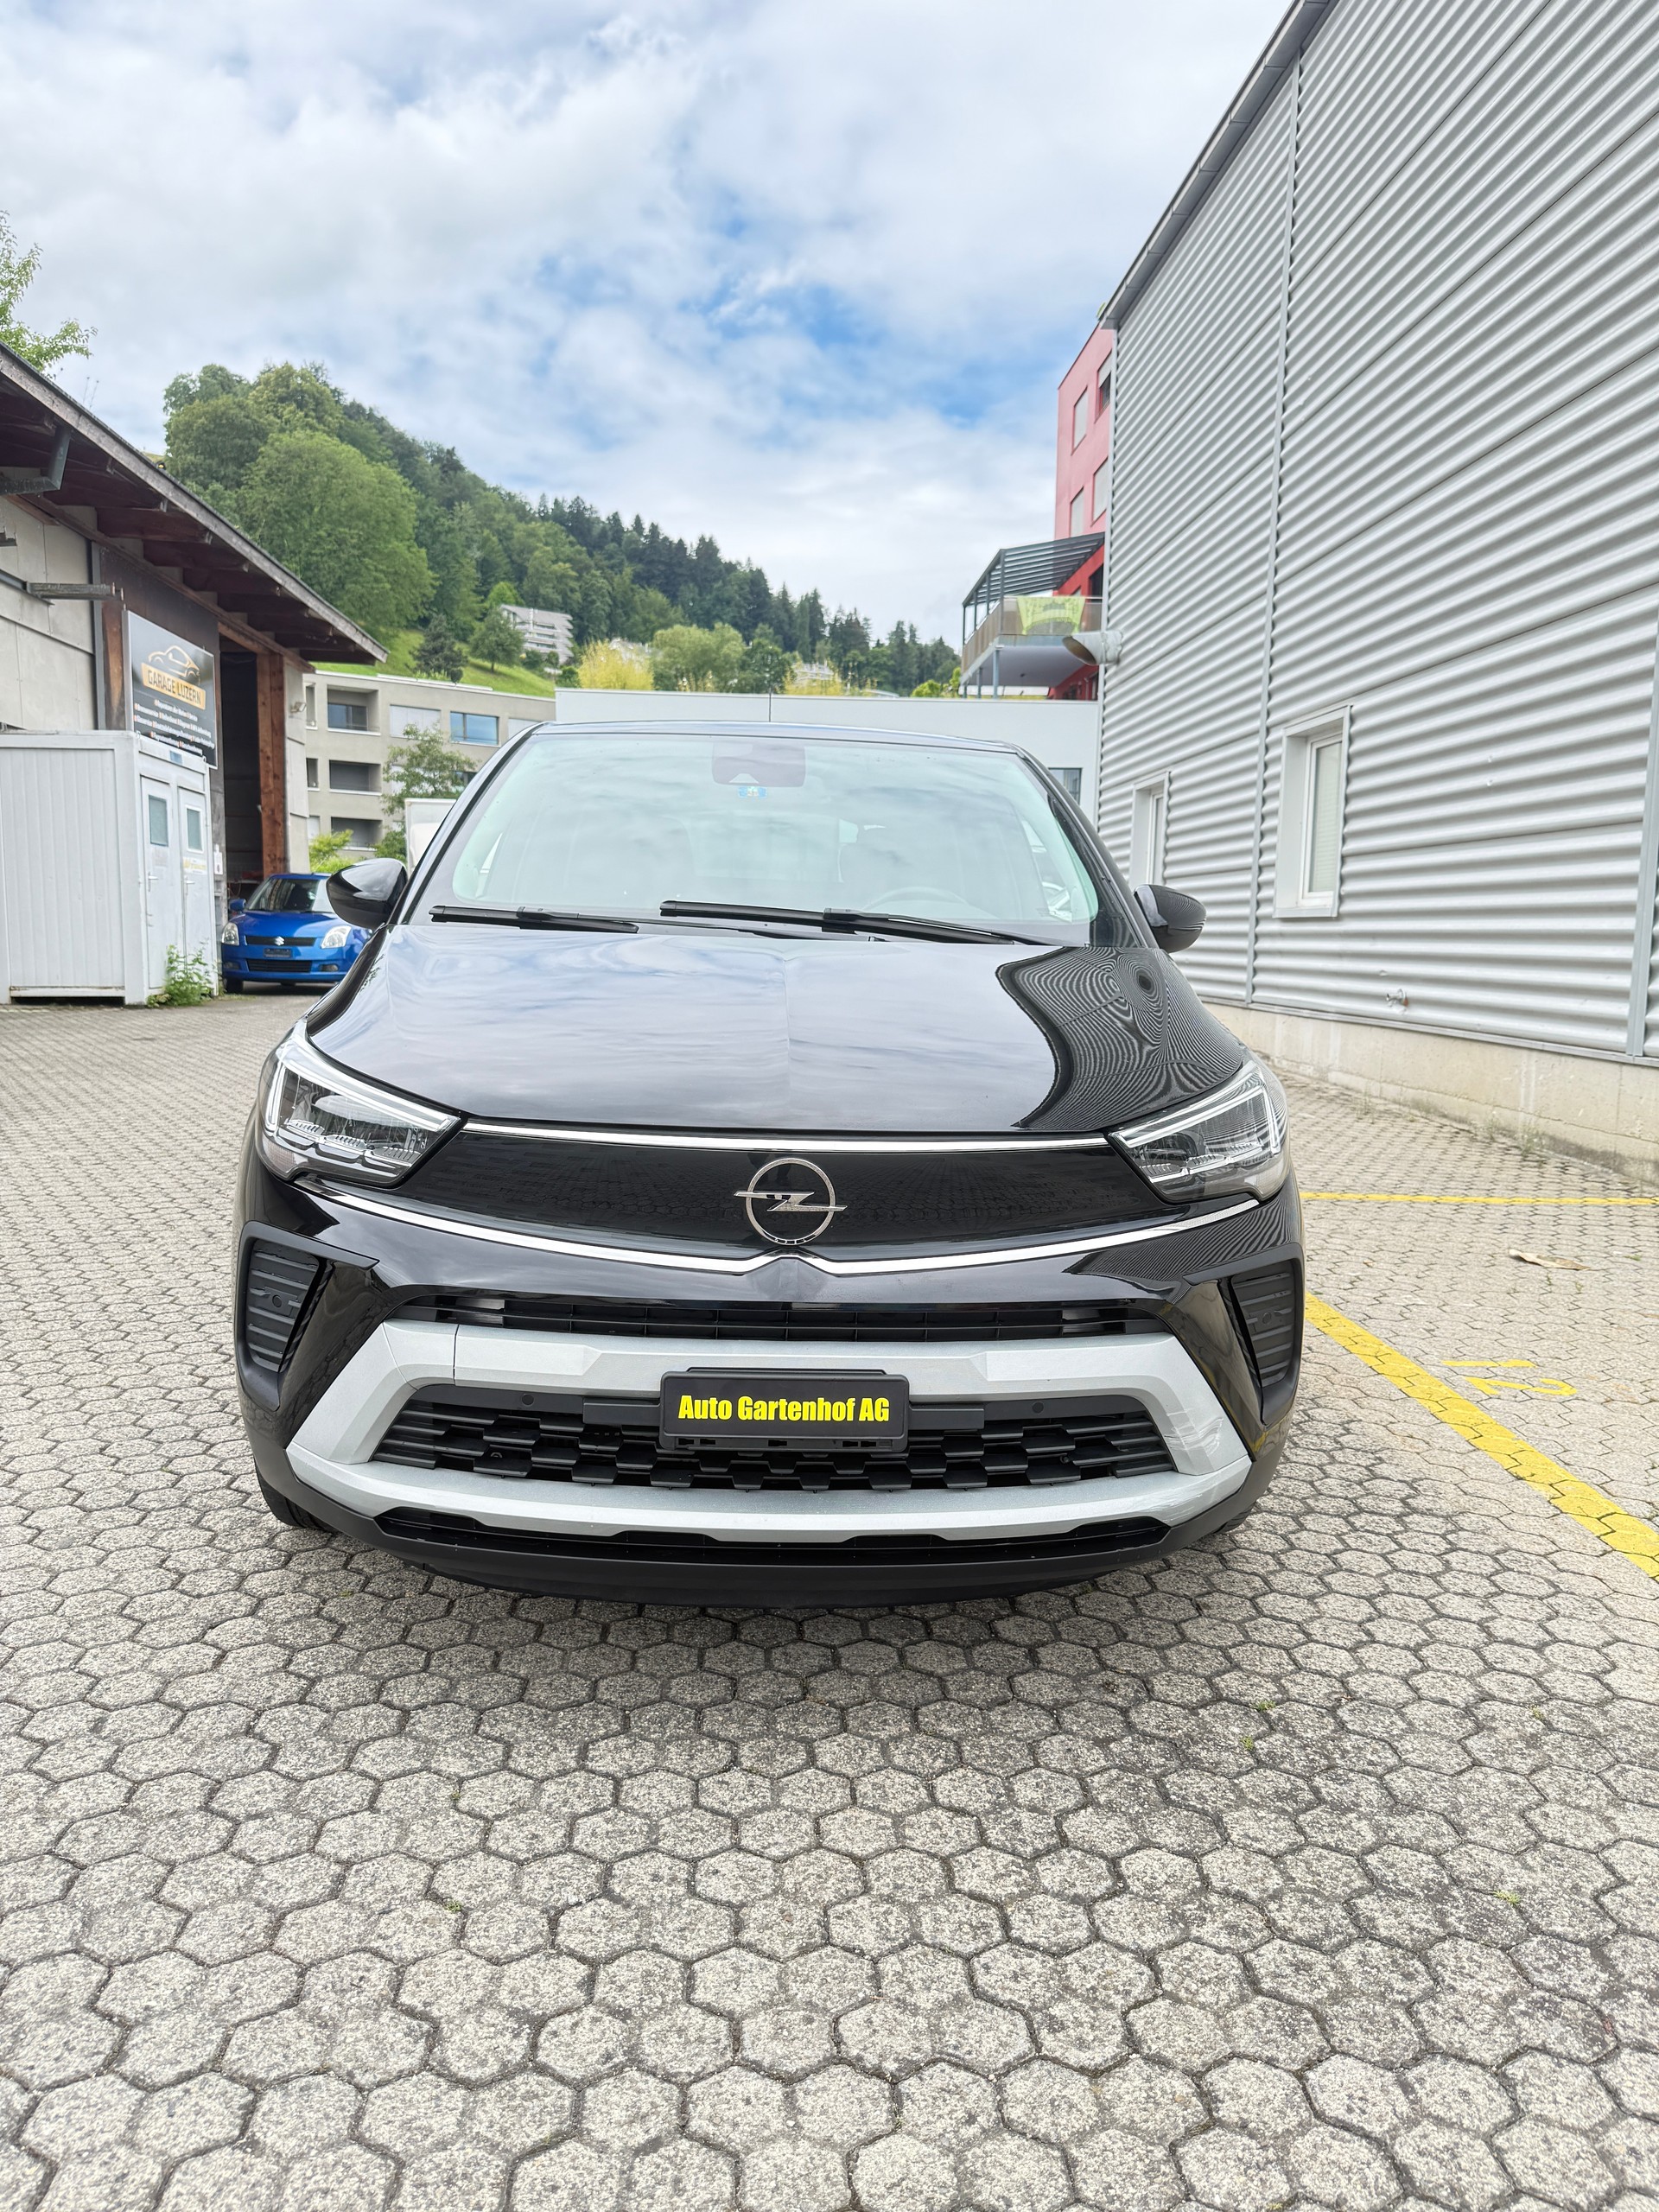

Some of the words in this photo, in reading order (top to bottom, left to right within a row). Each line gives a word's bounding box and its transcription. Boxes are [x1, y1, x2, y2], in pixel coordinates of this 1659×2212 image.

[148, 670, 175, 693] GARAGE
[177, 683, 201, 705] LUZERN
[678, 1395, 732, 1420] Auto
[738, 1396, 855, 1421] Gartenhof
[859, 1398, 889, 1421] AG
